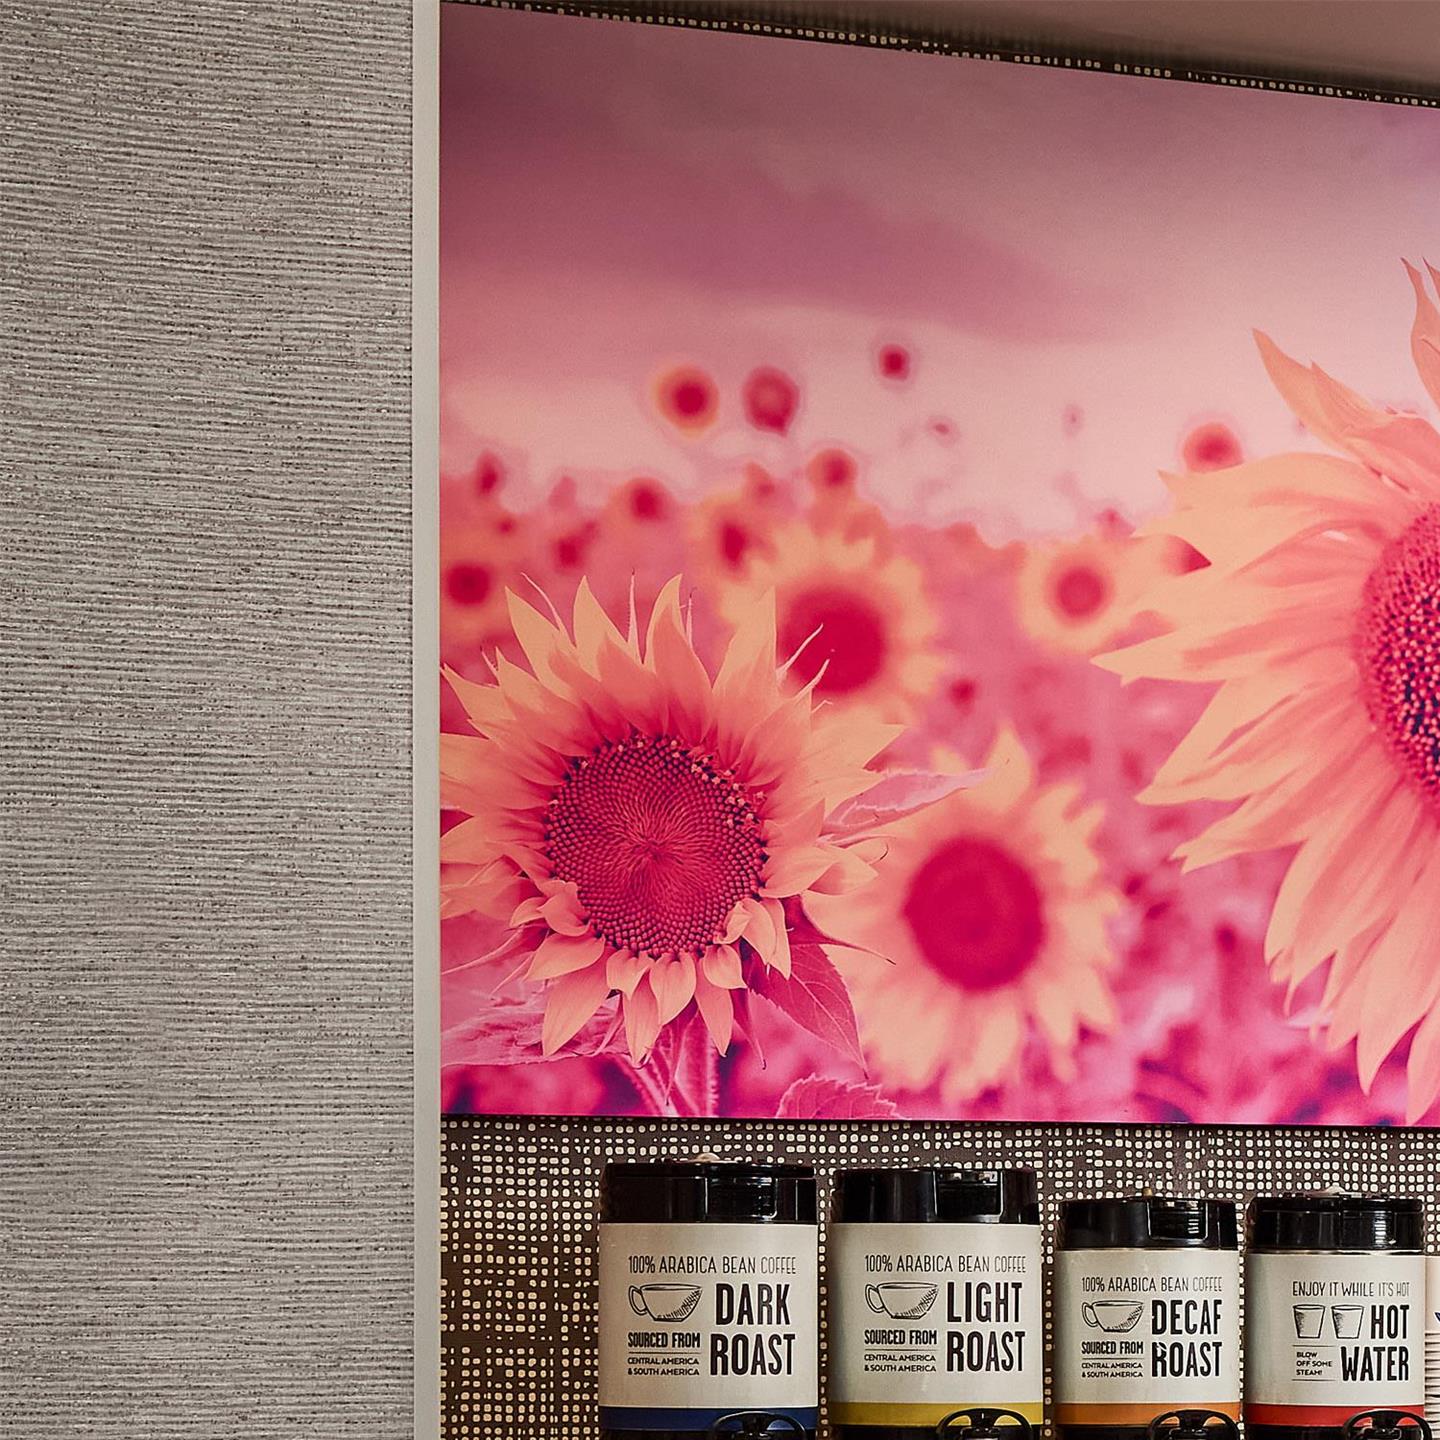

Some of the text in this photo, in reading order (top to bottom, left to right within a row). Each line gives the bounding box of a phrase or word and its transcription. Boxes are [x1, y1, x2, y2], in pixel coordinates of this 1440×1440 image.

[628, 1255, 796, 1274] 100% ARABICA BEAN COFFEE
[865, 1255, 1026, 1273] 100% ARABICA BEAN COFFEE
[1081, 1276, 1222, 1292] 100% ARABICA BEAN COFFEE
[1292, 1281, 1410, 1297] ENJOY IT WHILE IT'S HOT
[715, 1283, 790, 1325] DARK
[947, 1282, 1022, 1323] LIGHT
[1151, 1299, 1222, 1335] DECAF
[1370, 1304, 1410, 1339] HOT
[627, 1332, 701, 1348] SOURCED FROM
[864, 1329, 937, 1345] SOURCED FROM
[710, 1333, 796, 1375] ROAST
[946, 1331, 1026, 1372] ROAST
[1081, 1341, 1144, 1355] SOURCED FROM
[627, 1357, 699, 1365] CENTRAL AMERICA
[864, 1354, 936, 1362] CENTRAL AMERICA
[1151, 1341, 1222, 1377] ROAST
[1340, 1346, 1409, 1381] WATER
[633, 1368, 659, 1376] SOUTH
[660, 1368, 700, 1376] AMERICA
[870, 1364, 897, 1372] SOUTH
[897, 1364, 937, 1372] AMERICA
